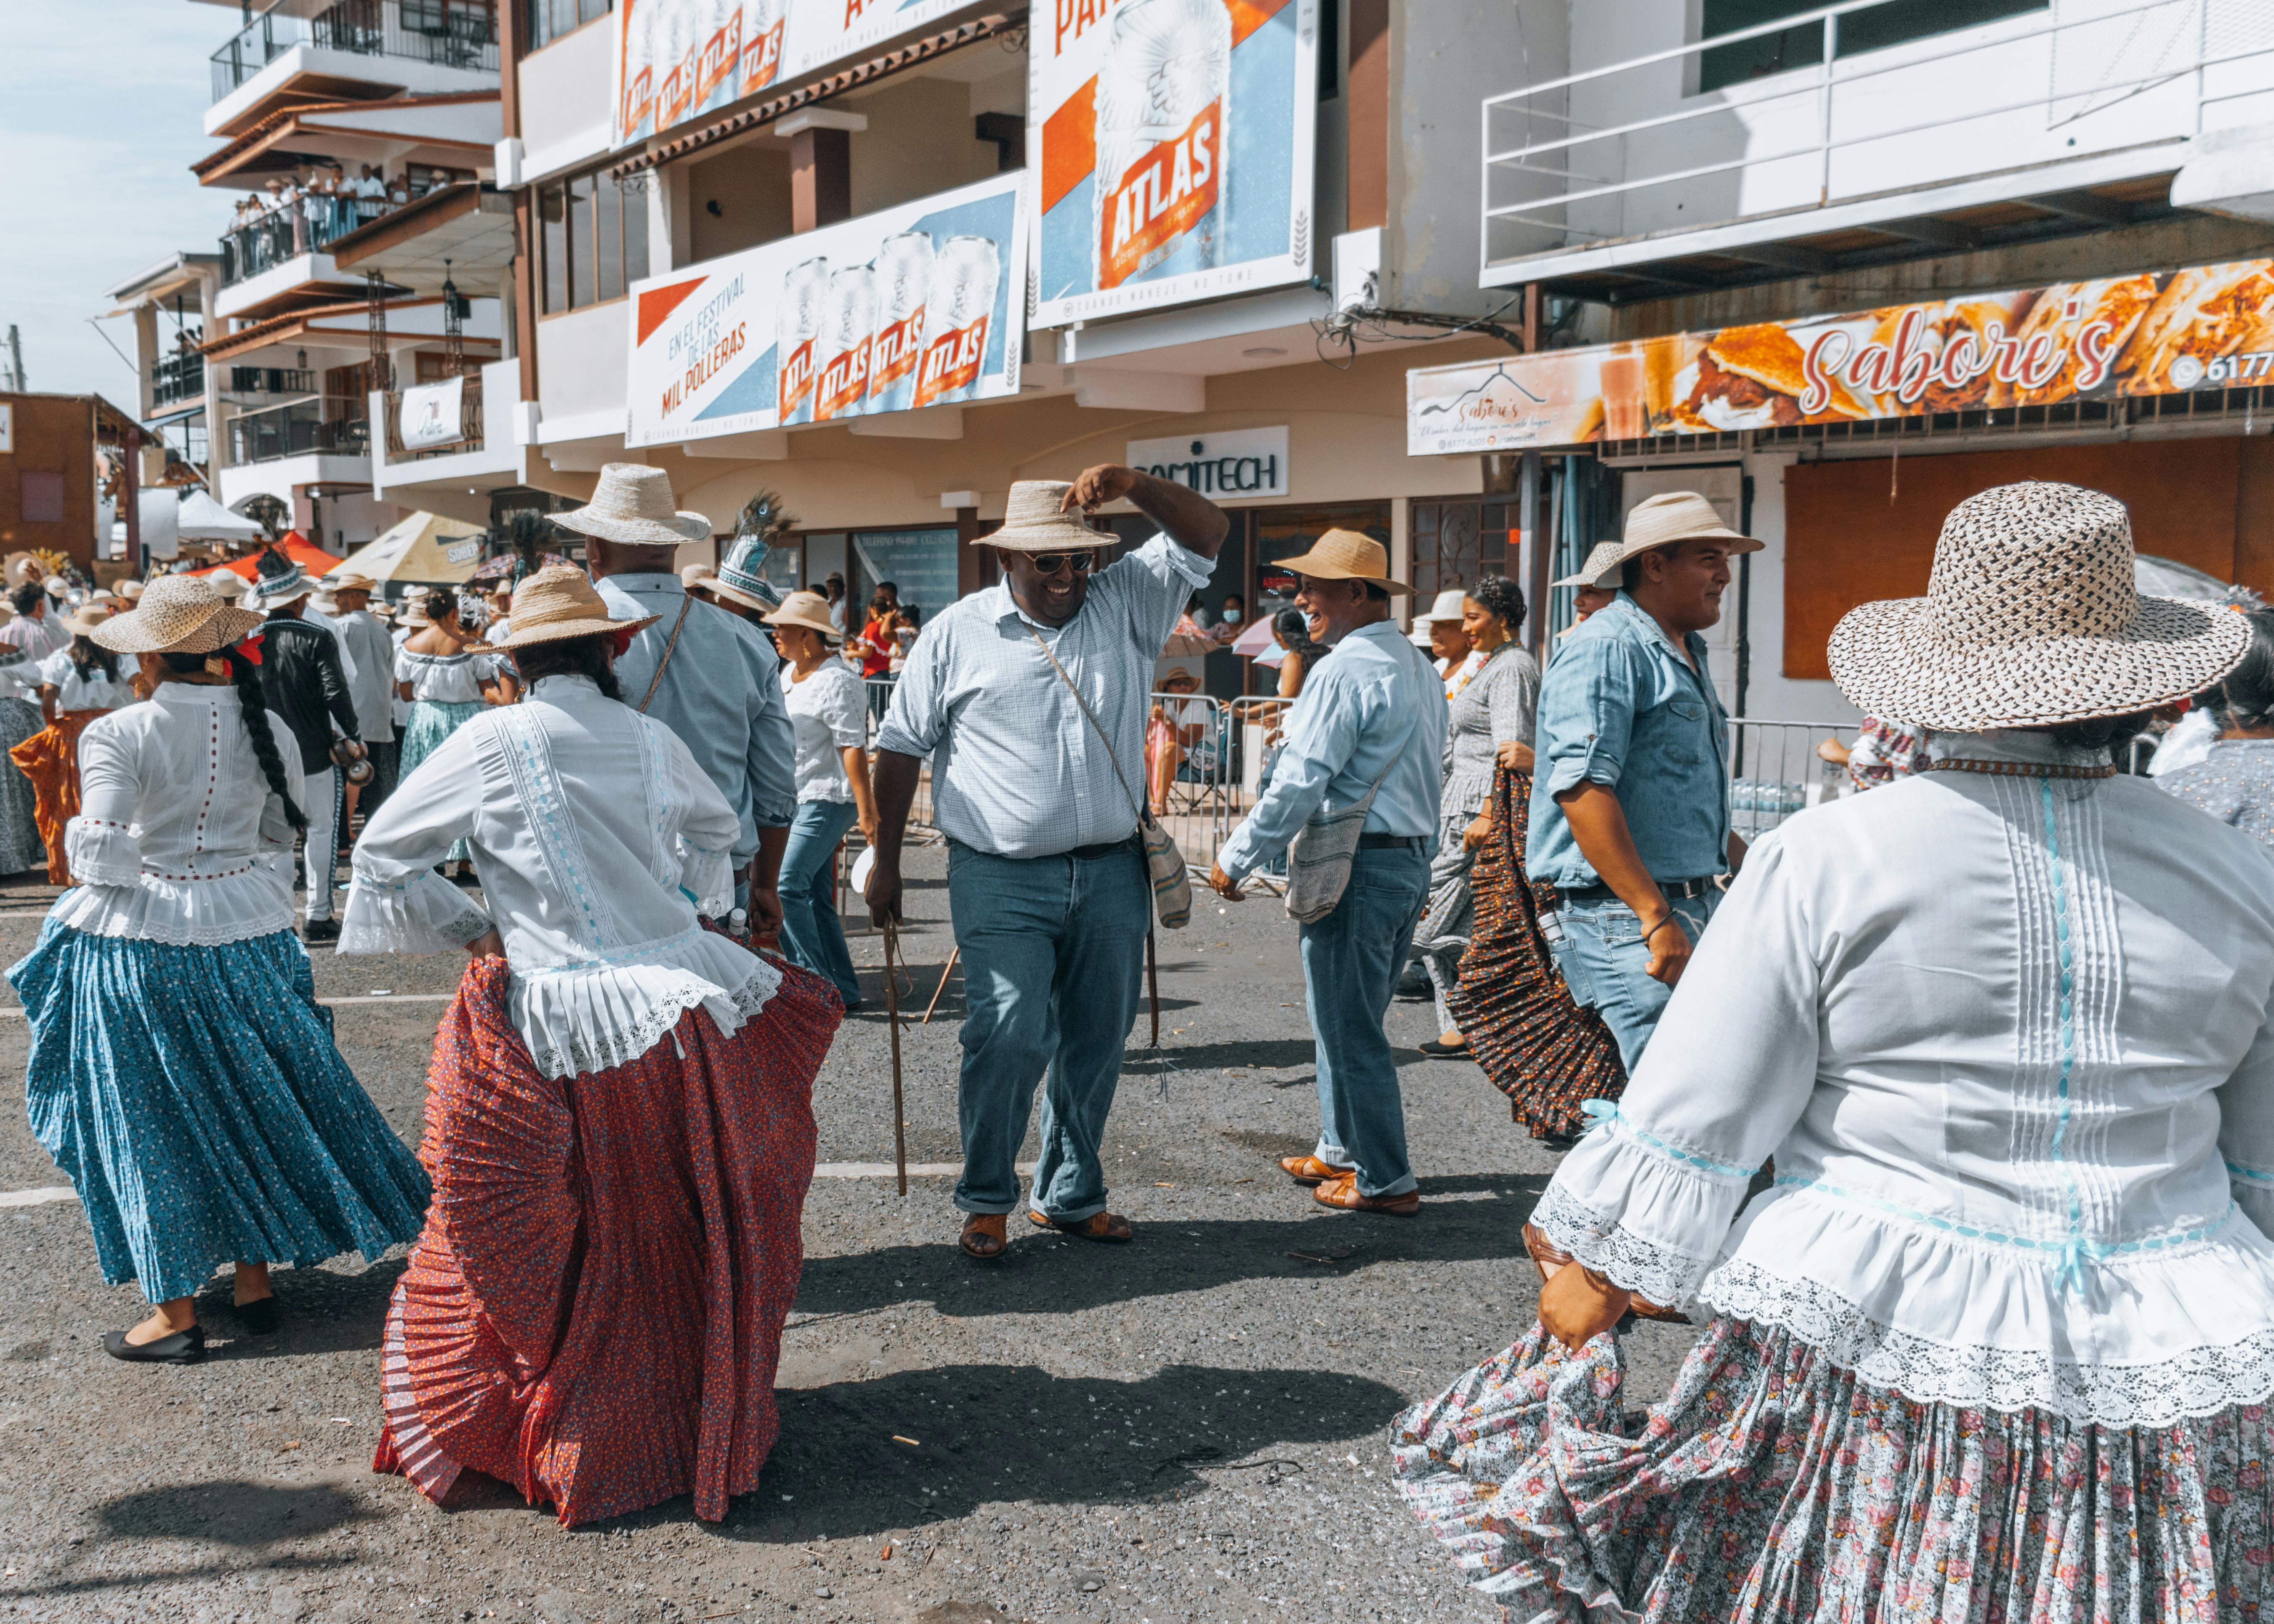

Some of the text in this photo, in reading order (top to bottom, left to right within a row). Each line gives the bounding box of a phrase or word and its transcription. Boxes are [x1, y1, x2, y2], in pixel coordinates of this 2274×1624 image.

[699, 17, 739, 90] ATLAS
[743, 27, 780, 82] TLAS
[1111, 120, 1212, 259] ATLAS
[669, 272, 745, 361] EN EL FESTIVAL
[1077, 296, 1120, 312] CUANDO
[1194, 277, 1207, 289] NO
[1219, 269, 1253, 284] TOME
[662, 321, 746, 420] MIL POLLERAS
[688, 322, 719, 367] DE LAS
[873, 314, 923, 376] ATLAS
[921, 326, 982, 388] ATLAS
[1799, 296, 2119, 415] Sabore's
[2207, 351, 2274, 381] 6177
[819, 345, 868, 410] ATLAS
[1459, 397, 1519, 423] Sabore's
[1133, 441, 1275, 492] MITECH
[1447, 438, 1485, 449] 6177-6205
